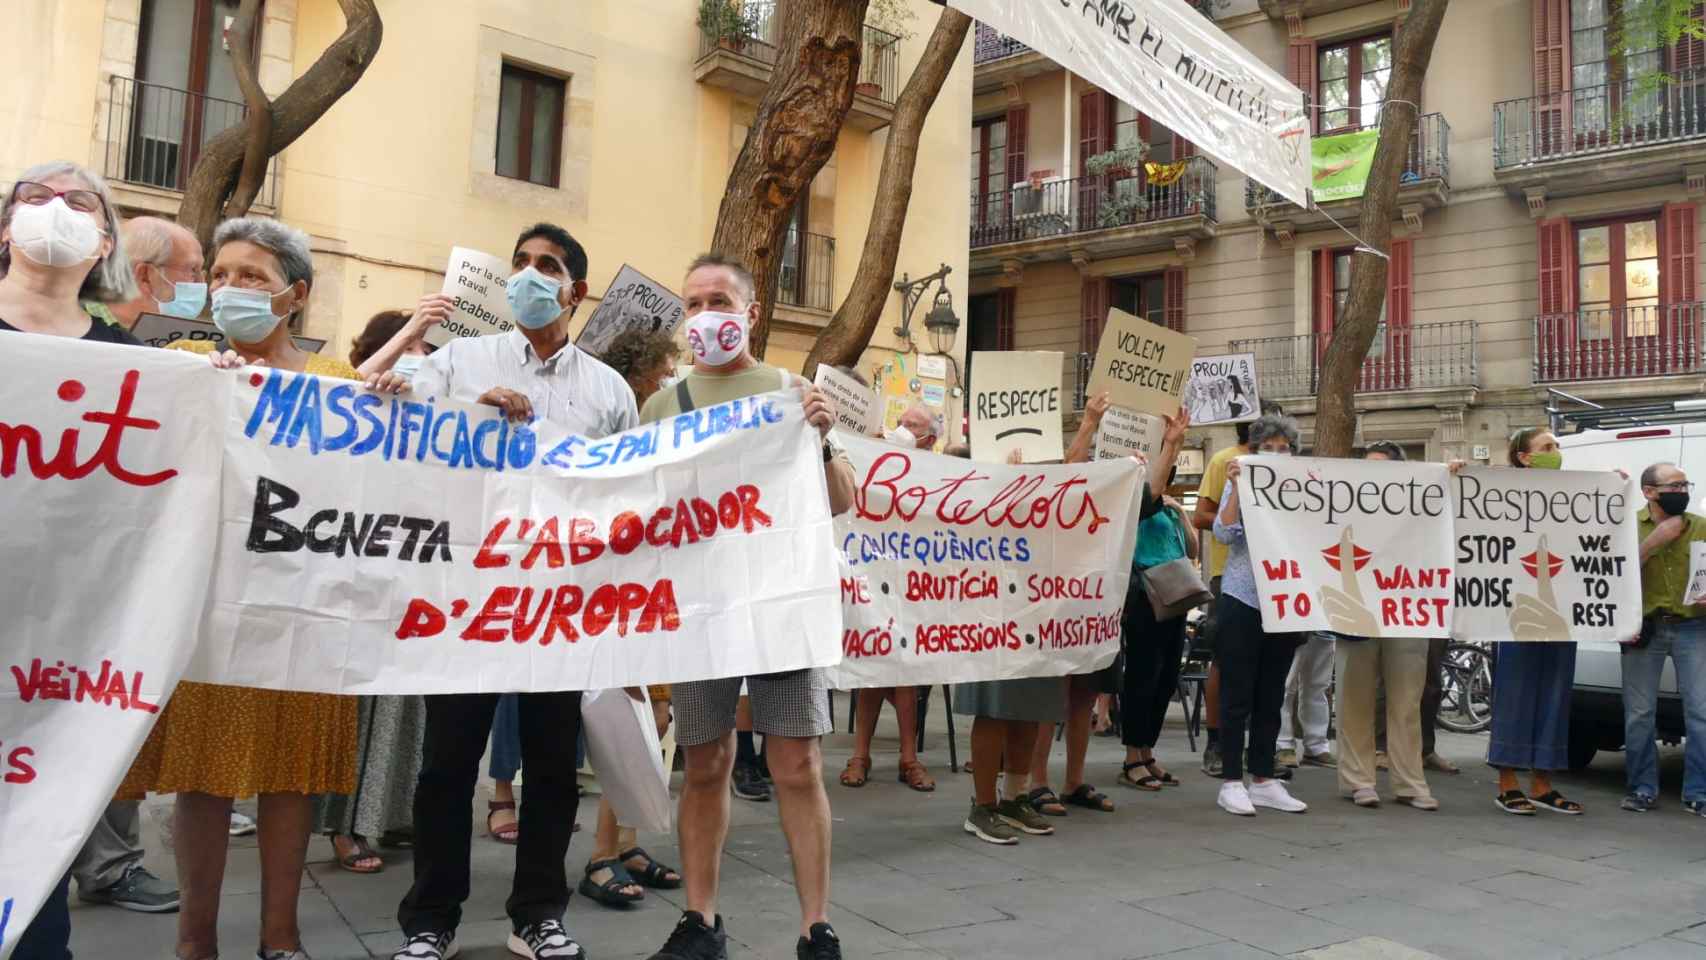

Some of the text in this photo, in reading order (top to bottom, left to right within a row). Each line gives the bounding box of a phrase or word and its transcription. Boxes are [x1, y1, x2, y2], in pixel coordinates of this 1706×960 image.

[461, 261, 482, 274] Per
[484, 268, 493, 280] la
[452, 295, 499, 326] acabeu
[1117, 329, 1166, 363] VOLEM
[1108, 359, 1185, 397] RESPECTE!!!
[1193, 359, 1234, 377] PROU!
[977, 387, 1059, 421] RESPECTE
[840, 414, 857, 430] dret
[541, 420, 661, 469] ESPAI
[1123, 438, 1141, 450] dret
[854, 452, 1110, 535] Botellots
[1247, 464, 1444, 525] Respecte
[1456, 475, 1625, 533] Respecte
[246, 475, 773, 570] BCNETA L'ABOCADOR
[1457, 534, 1516, 565] STOP
[1578, 534, 1611, 553] WE
[1262, 559, 1451, 591] WE WANT
[1571, 555, 1626, 578] WANT
[1027, 574, 1104, 603] SOROLL
[1454, 577, 1513, 608] NOISE
[1584, 578, 1610, 601] TO
[395, 578, 681, 646] D'EUROPA
[1271, 592, 1450, 628] TO REST
[1572, 603, 1618, 628] REST
[0, 741, 37, 785] S
